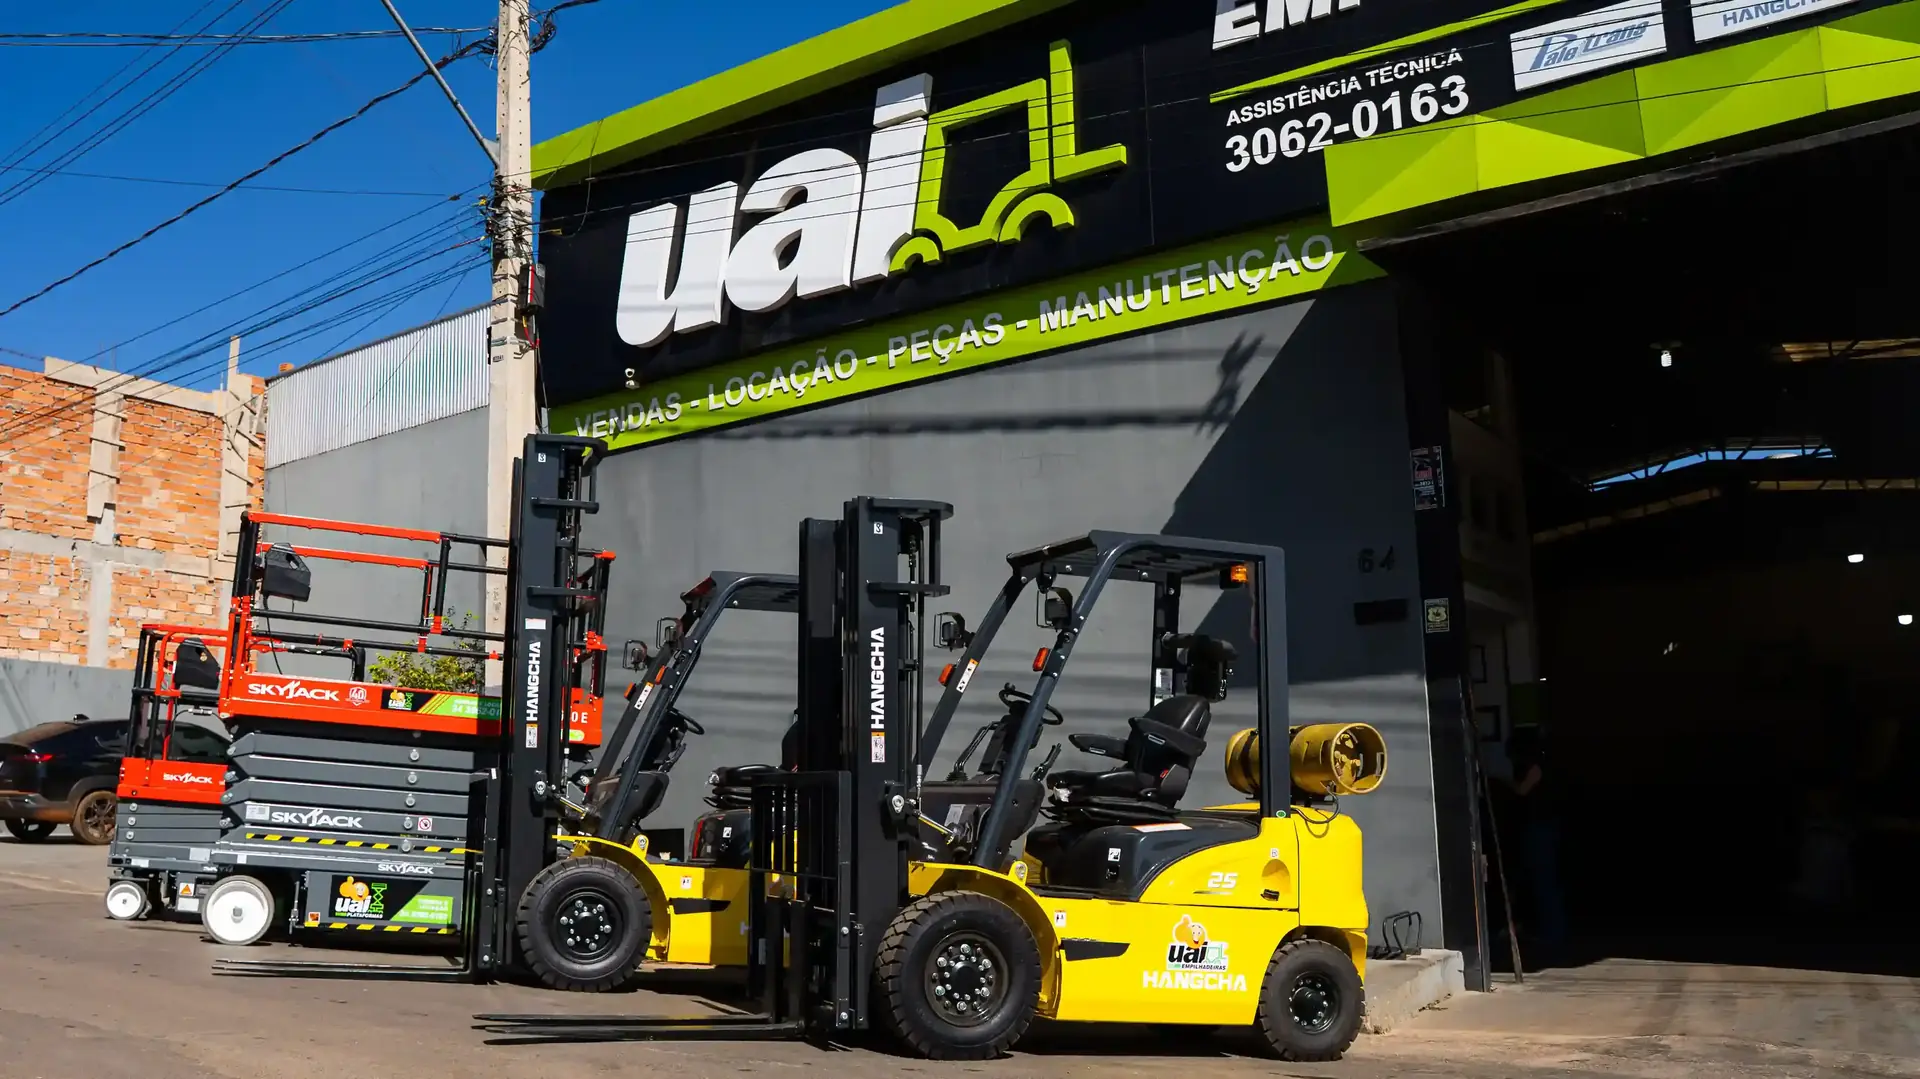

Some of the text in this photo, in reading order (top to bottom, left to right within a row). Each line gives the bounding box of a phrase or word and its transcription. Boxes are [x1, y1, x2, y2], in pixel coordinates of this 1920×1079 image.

[1226, 48, 1463, 127] ASSISTÊNCIA TÉCNICA
[1225, 75, 1469, 173] 3062-0163
[616, 73, 933, 348] uai
[574, 392, 682, 438] VENDAS
[708, 347, 857, 411] LOCAÇÃO
[888, 312, 1005, 368] PEÇAS
[1039, 233, 1334, 333] MANUTENÇÃO
[526, 641, 541, 721] HANGCHA
[870, 626, 885, 729] HANGCHA
[248, 680, 340, 701] SKYJACK
[163, 773, 213, 784] SKYJACK
[271, 808, 363, 828] SKYJACK
[377, 862, 434, 875] SKYJACK
[1207, 871, 1238, 889] 25
[335, 895, 372, 913] uai
[1168, 941, 1208, 963] uai
[1181, 963, 1227, 971] EMPILHADEIRAS
[1142, 971, 1247, 991] HANGCHA
